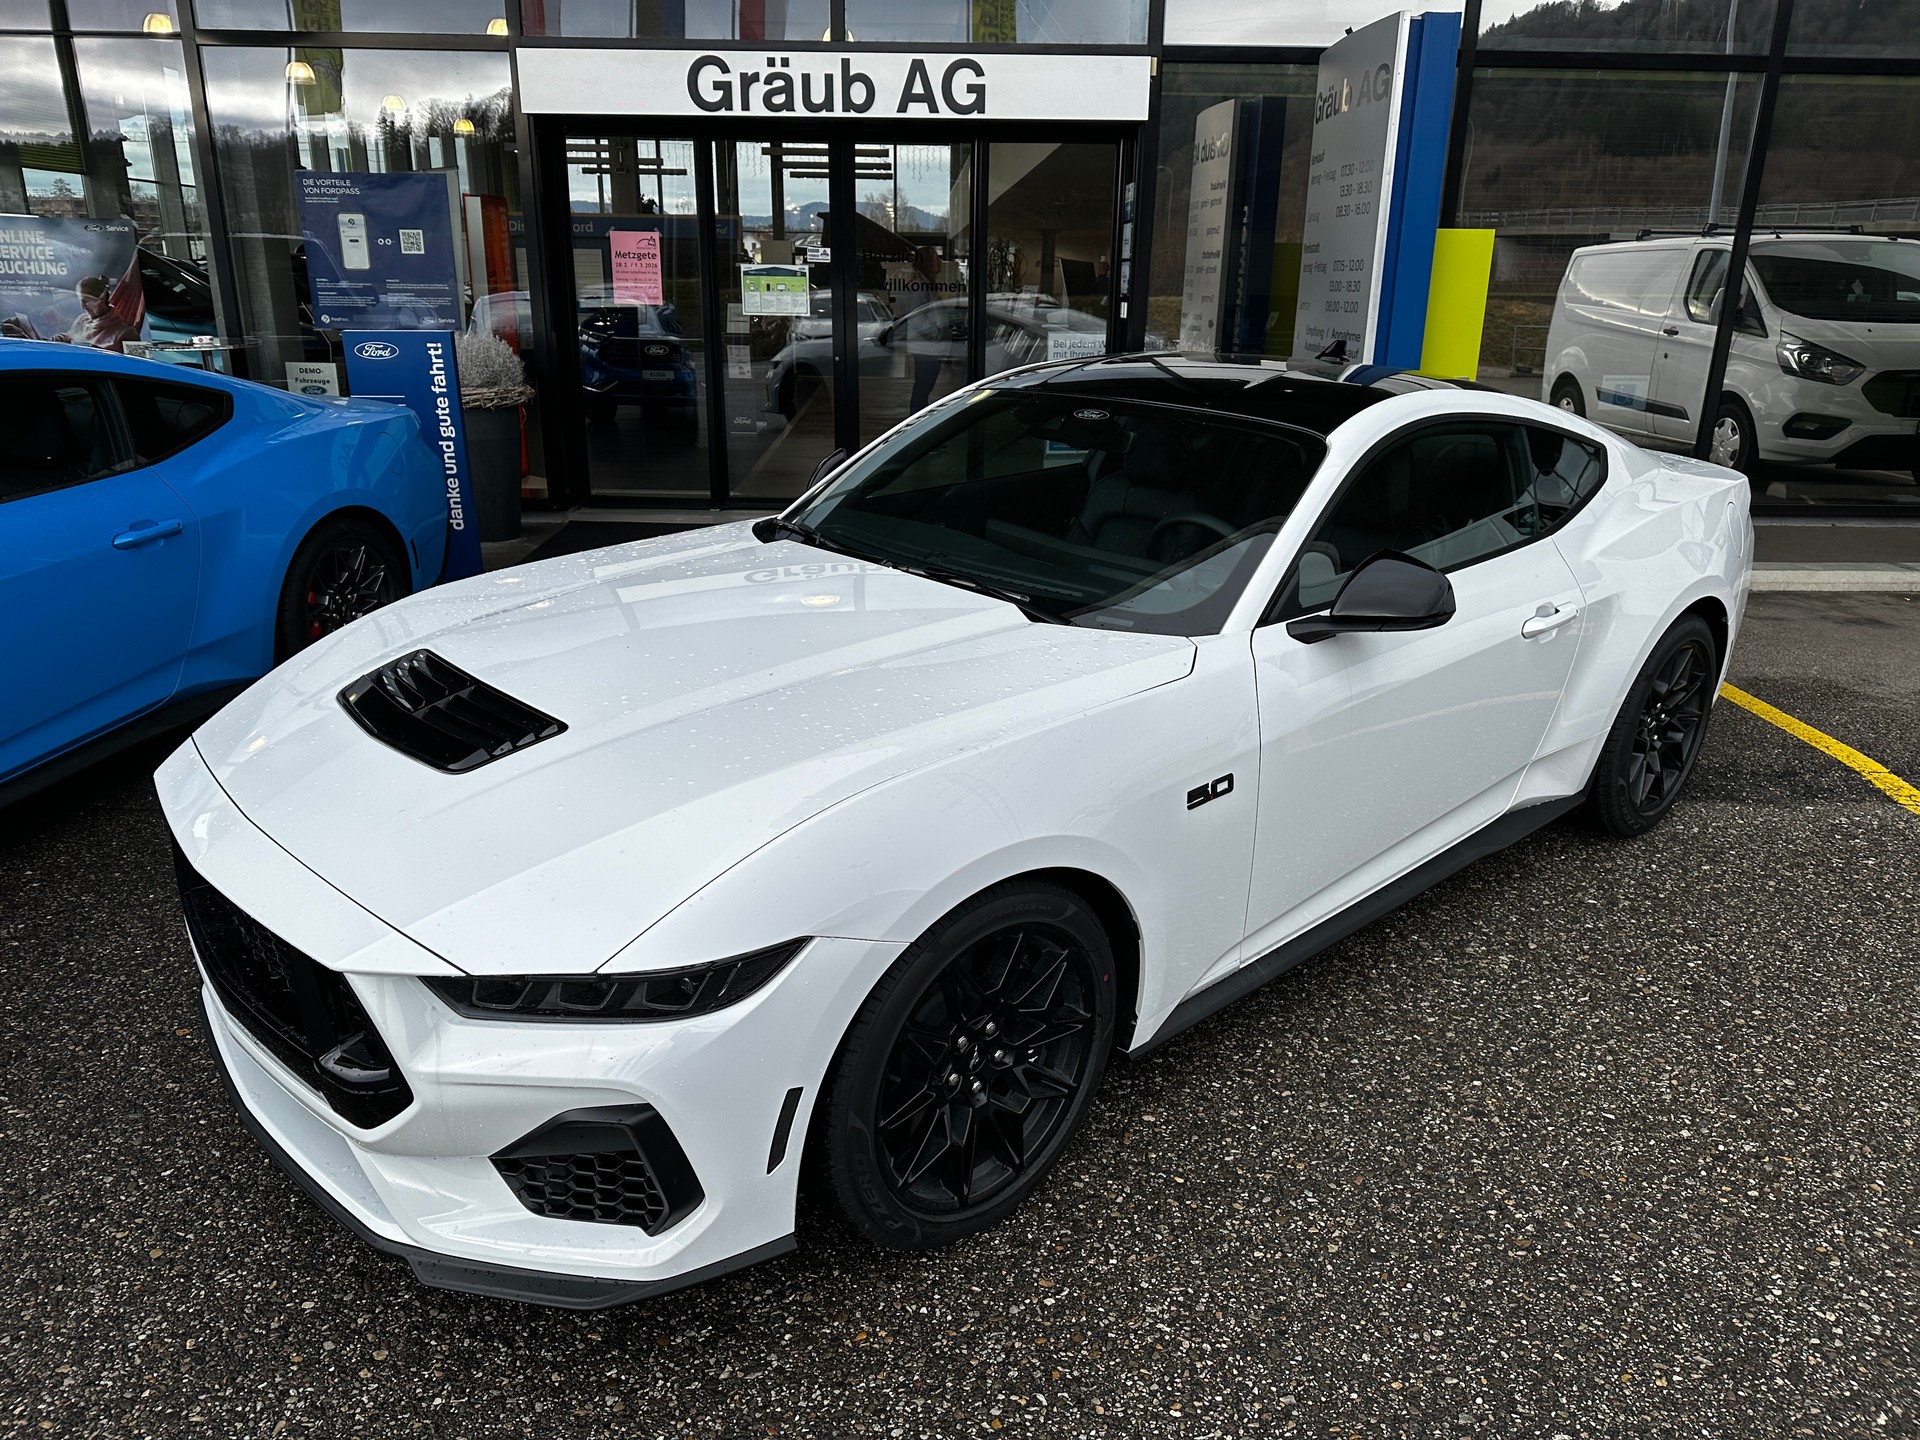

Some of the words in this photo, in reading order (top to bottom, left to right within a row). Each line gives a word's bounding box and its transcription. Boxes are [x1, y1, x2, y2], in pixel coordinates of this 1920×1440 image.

[687, 55, 875, 113] Gräub
[896, 58, 986, 114] AG
[1315, 78, 1353, 125] Gräub
[1356, 62, 1391, 108] AG
[302, 178, 314, 186] DIE
[316, 179, 351, 187] VORTEILE
[304, 187, 320, 195] VON
[320, 188, 361, 196] FORDPASS
[572, 221, 594, 233] ord
[0, 230, 46, 244] NLINE
[614, 250, 658, 262] Metzgete
[879, 278, 967, 293] willkommen
[1331, 329, 1361, 343] Annahme
[361, 342, 392, 358] Ford
[1053, 339, 1067, 349] Bei
[1068, 339, 1096, 350] jedem
[1053, 350, 1068, 359] mit
[1069, 350, 1095, 359] Ihrem
[298, 367, 324, 375] DEMO-
[427, 342, 448, 394] fahrt!
[294, 377, 331, 386] Fahrzeuge
[436, 397, 456, 438] gute
[438, 441, 457, 474] und
[447, 478, 465, 531] danke
[1187, 772, 1234, 811] 5.0
